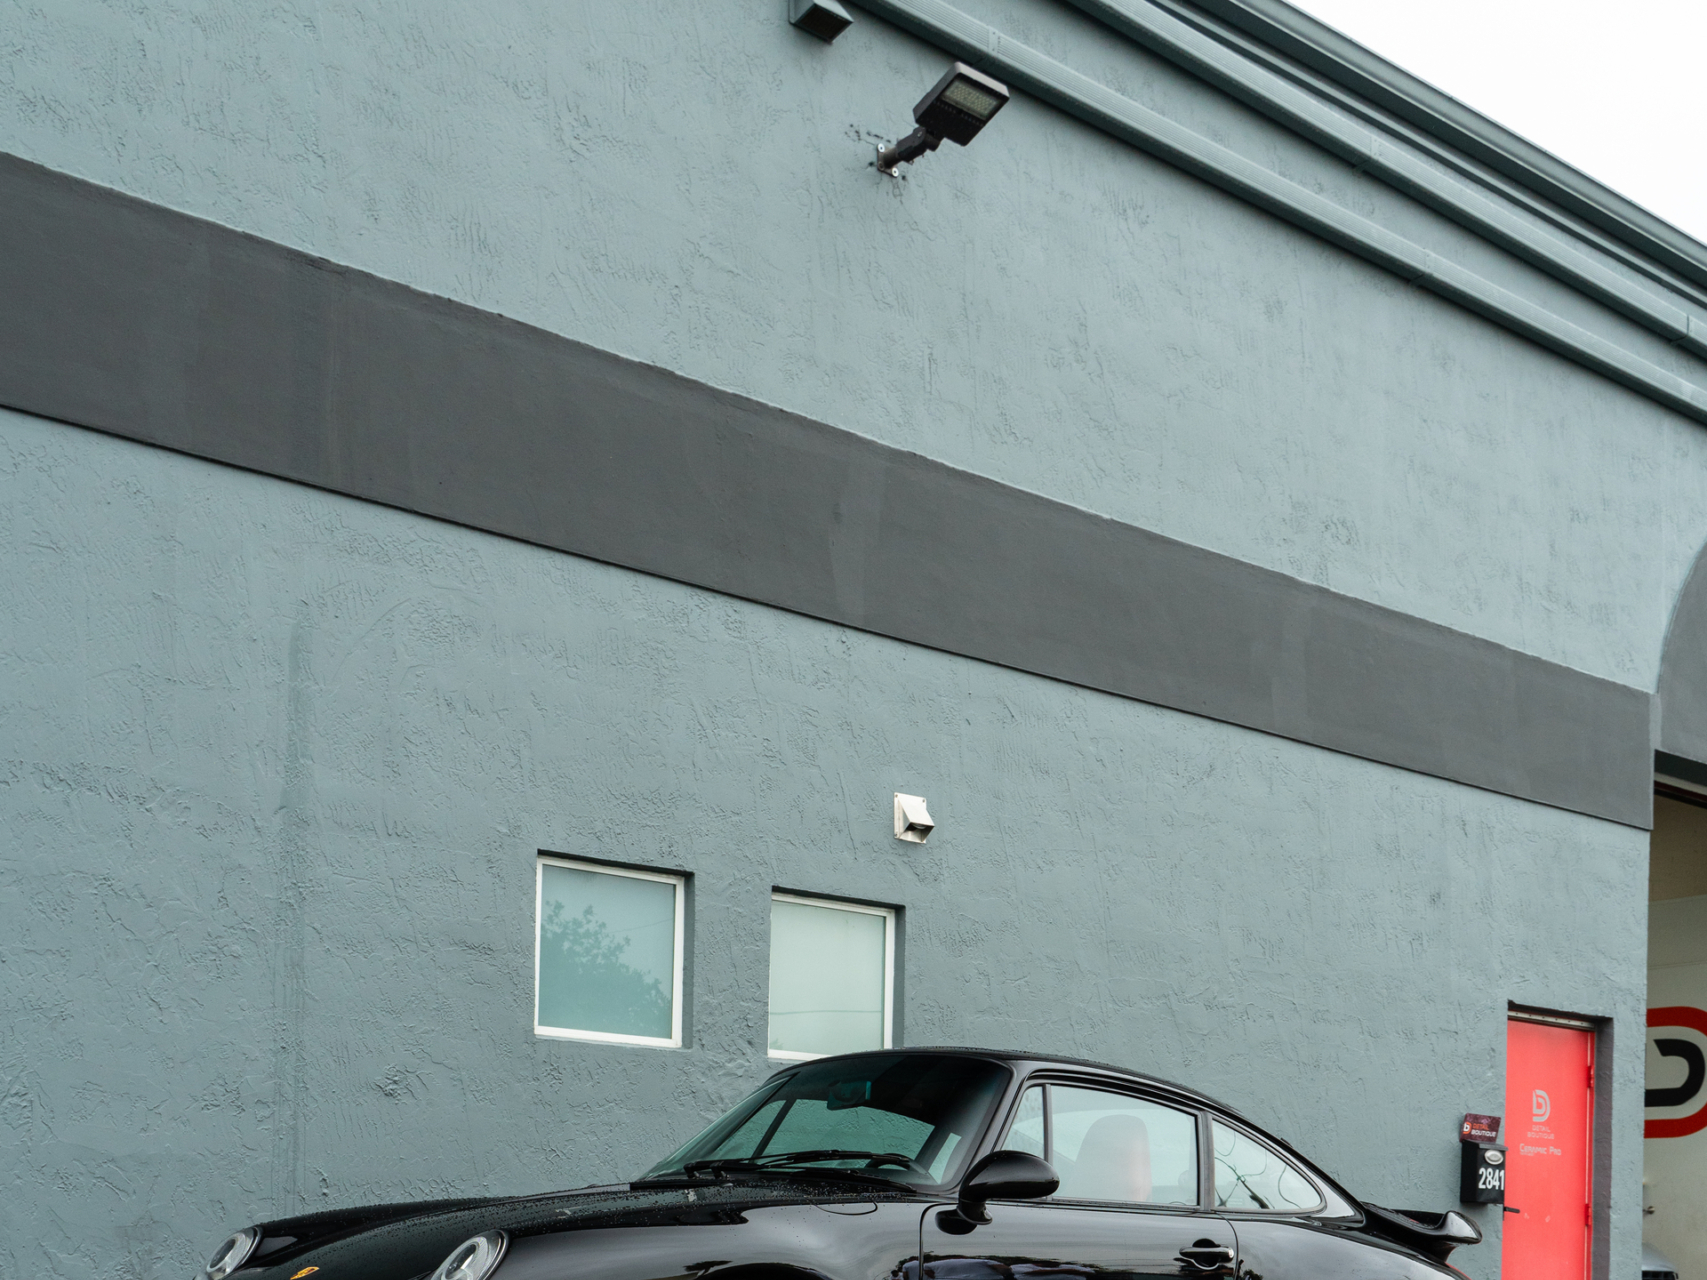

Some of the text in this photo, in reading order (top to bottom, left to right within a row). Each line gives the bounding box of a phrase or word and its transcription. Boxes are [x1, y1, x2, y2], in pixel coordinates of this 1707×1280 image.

[1532, 1124, 1551, 1133] DETAIL
[1471, 1129, 1497, 1138] BOUTIQUE
[1527, 1131, 1555, 1140] BOUTIQUE
[1478, 1167, 1504, 1190] 2841
